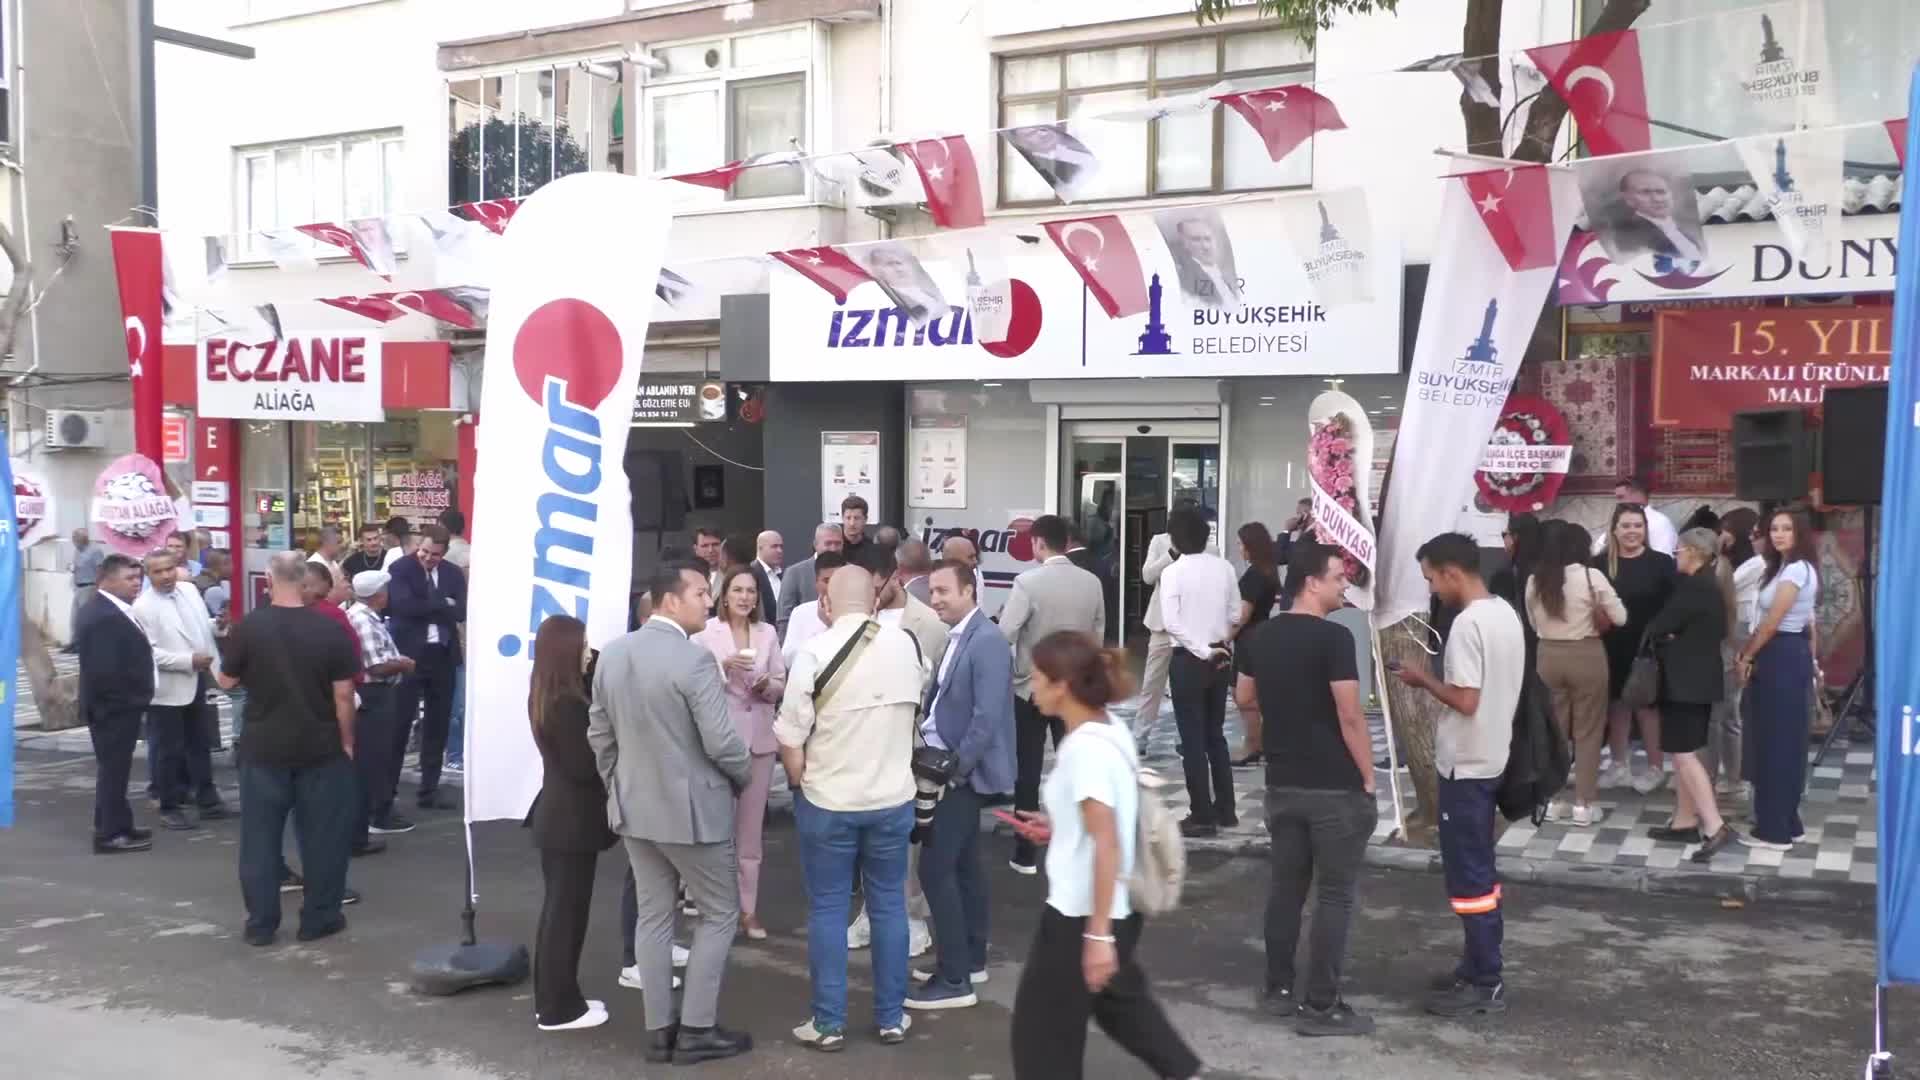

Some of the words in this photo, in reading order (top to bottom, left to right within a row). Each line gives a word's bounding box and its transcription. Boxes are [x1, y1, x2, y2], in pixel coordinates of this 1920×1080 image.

[1193, 331, 1309, 355] BELEDİYESİ
[1731, 320, 1788, 355] 15.
[206, 337, 365, 382] ECZANE
[1690, 365, 1796, 381] MARKALI
[254, 388, 315, 412] ALİAĞA
[1322, 503, 1373, 562] DÜNYASI
